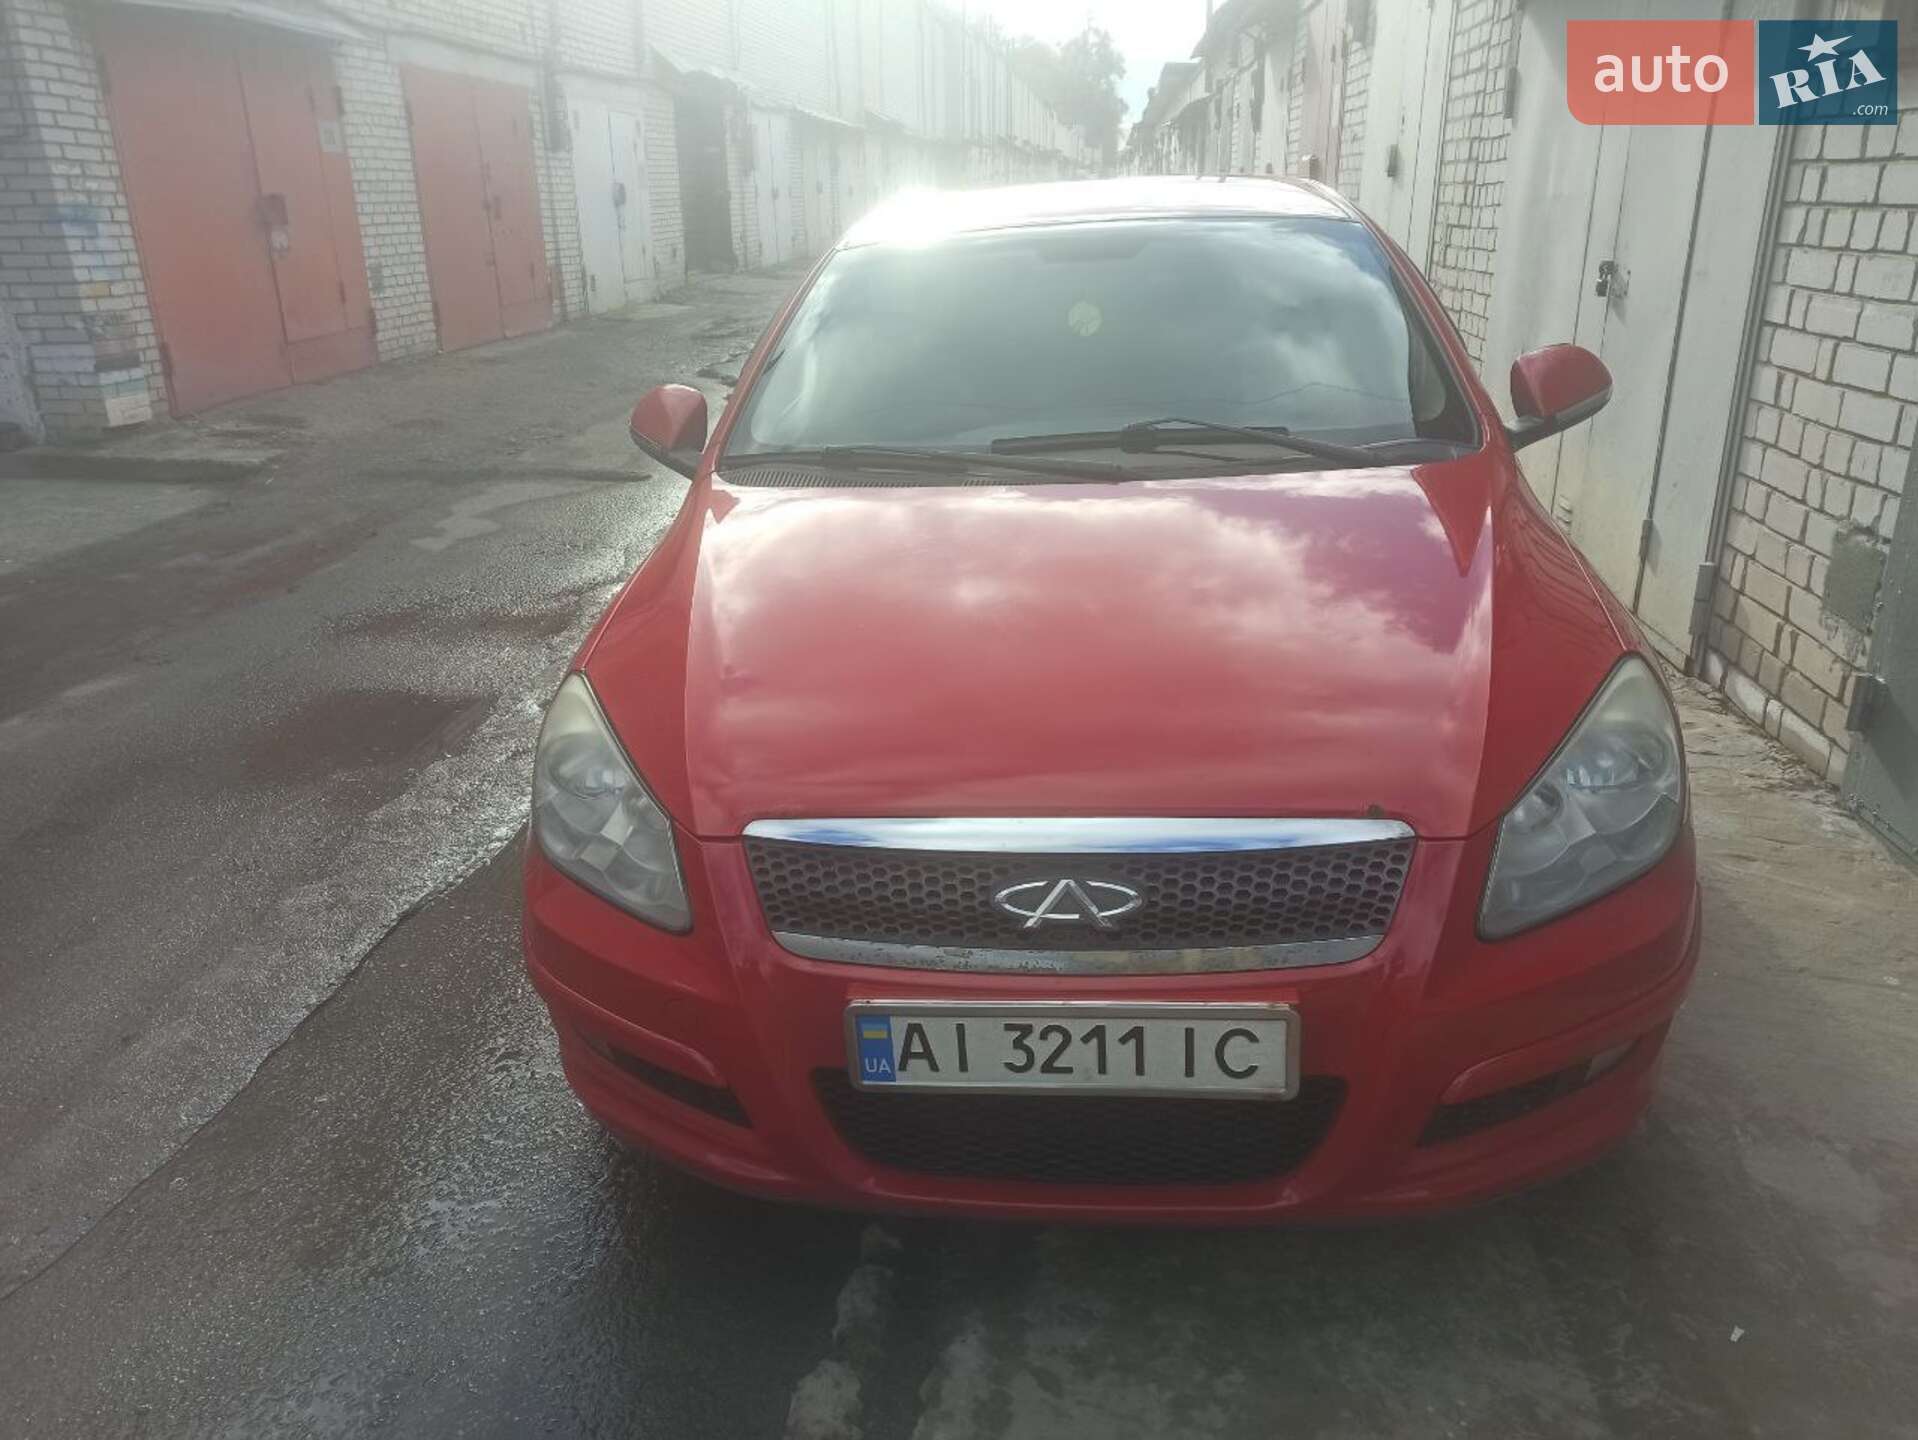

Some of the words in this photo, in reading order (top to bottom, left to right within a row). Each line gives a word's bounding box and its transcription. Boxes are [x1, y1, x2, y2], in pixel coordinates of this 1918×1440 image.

[864, 1057, 892, 1074] UA
[897, 1022, 969, 1073] AI
[1003, 1022, 1146, 1077] 3211
[1183, 1027, 1260, 1080] IC
